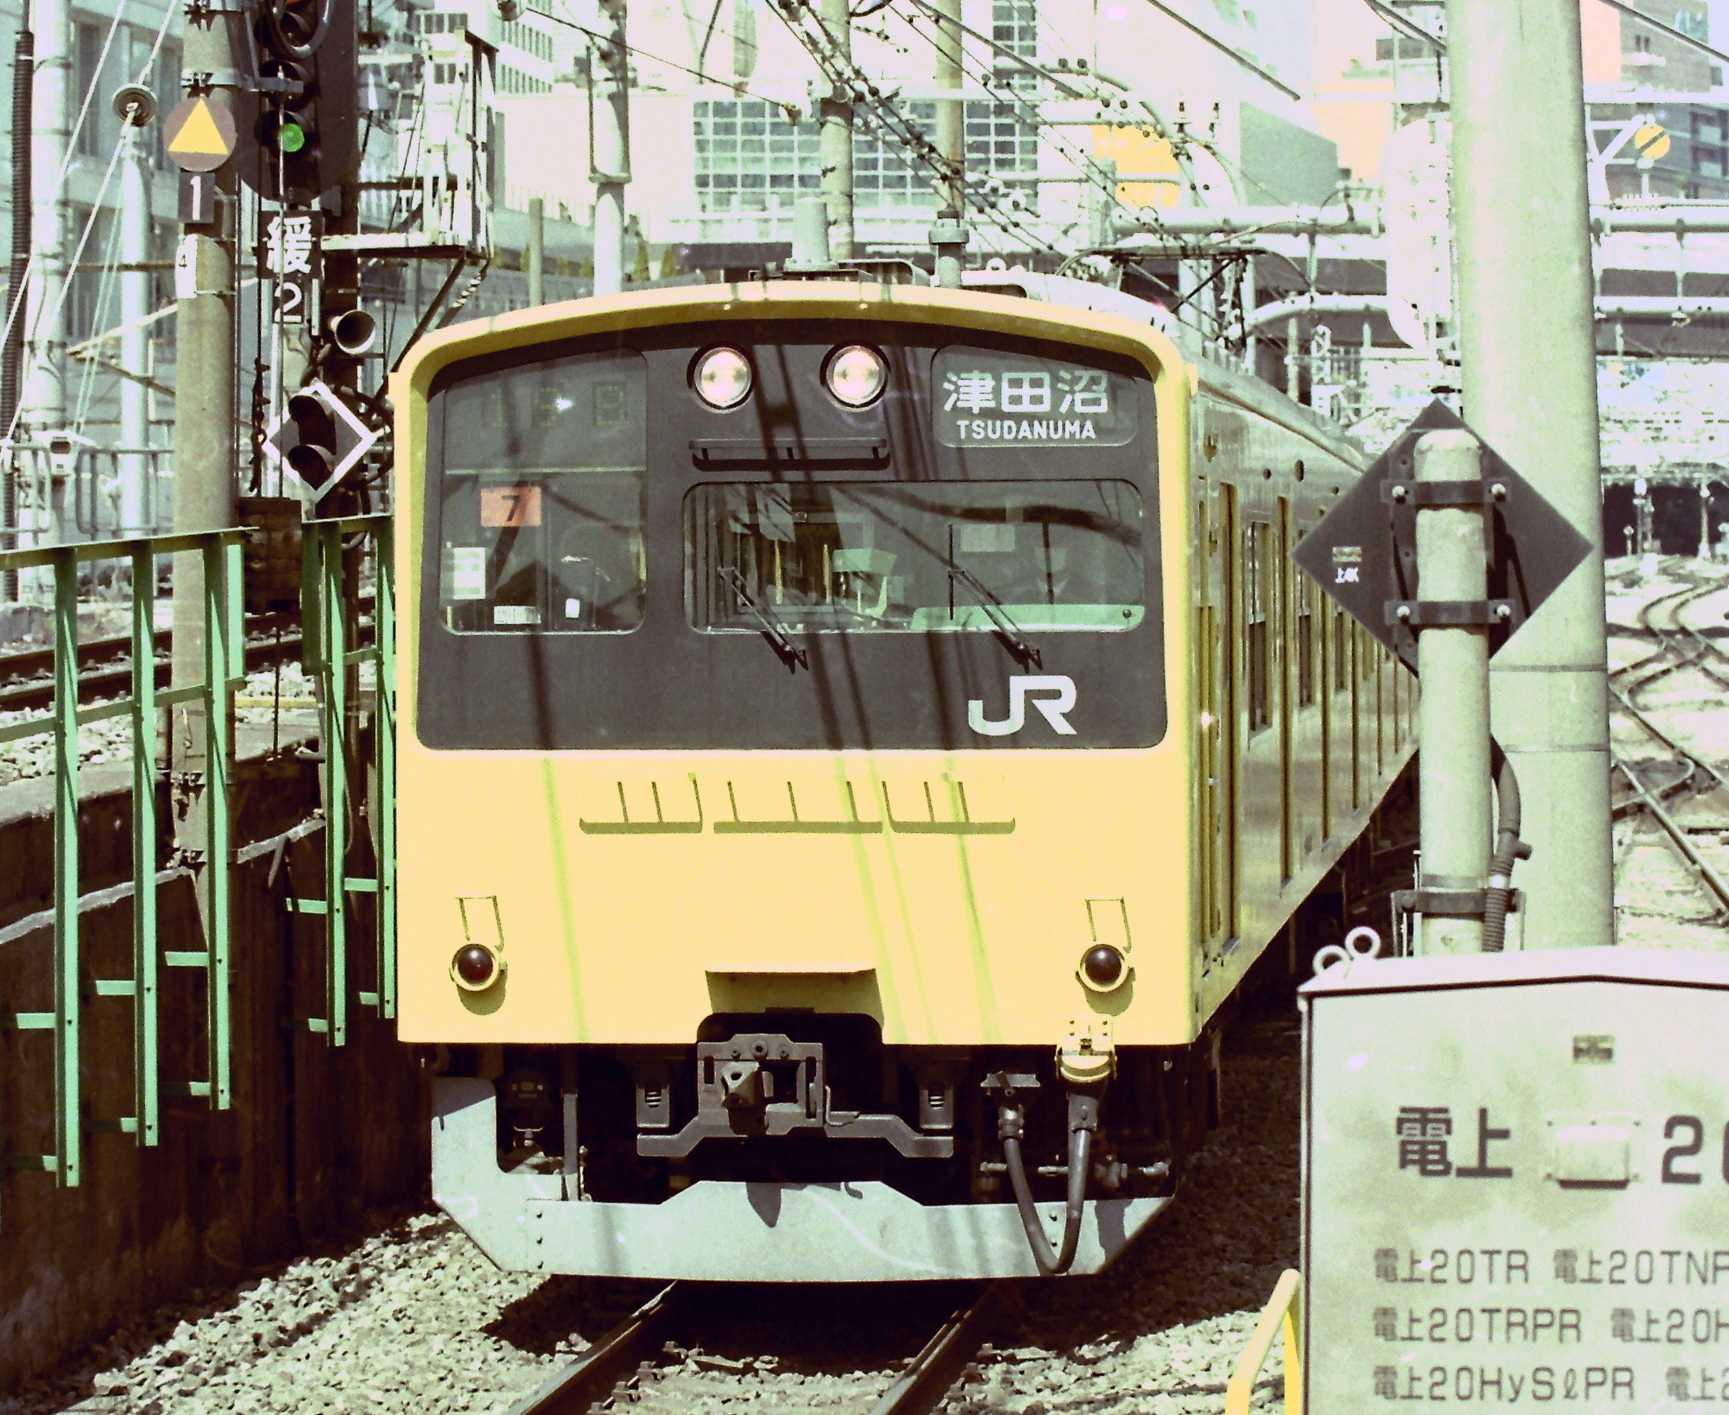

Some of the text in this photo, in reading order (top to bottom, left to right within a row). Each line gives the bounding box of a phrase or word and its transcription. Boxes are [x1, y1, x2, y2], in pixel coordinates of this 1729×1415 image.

[189, 176, 201, 221] 1
[266, 216, 312, 274] 緩
[274, 282, 302, 322] 2
[943, 370, 1108, 414] 津田沼
[956, 419, 1096, 440] TSUDANUMA
[501, 495, 521, 522] 7
[967, 675, 1077, 736] JR
[1396, 1107, 1729, 1186] 電上 2
[1374, 1248, 1529, 1285] 電上20TR
[1373, 1307, 1582, 1344] 電上20TRPR
